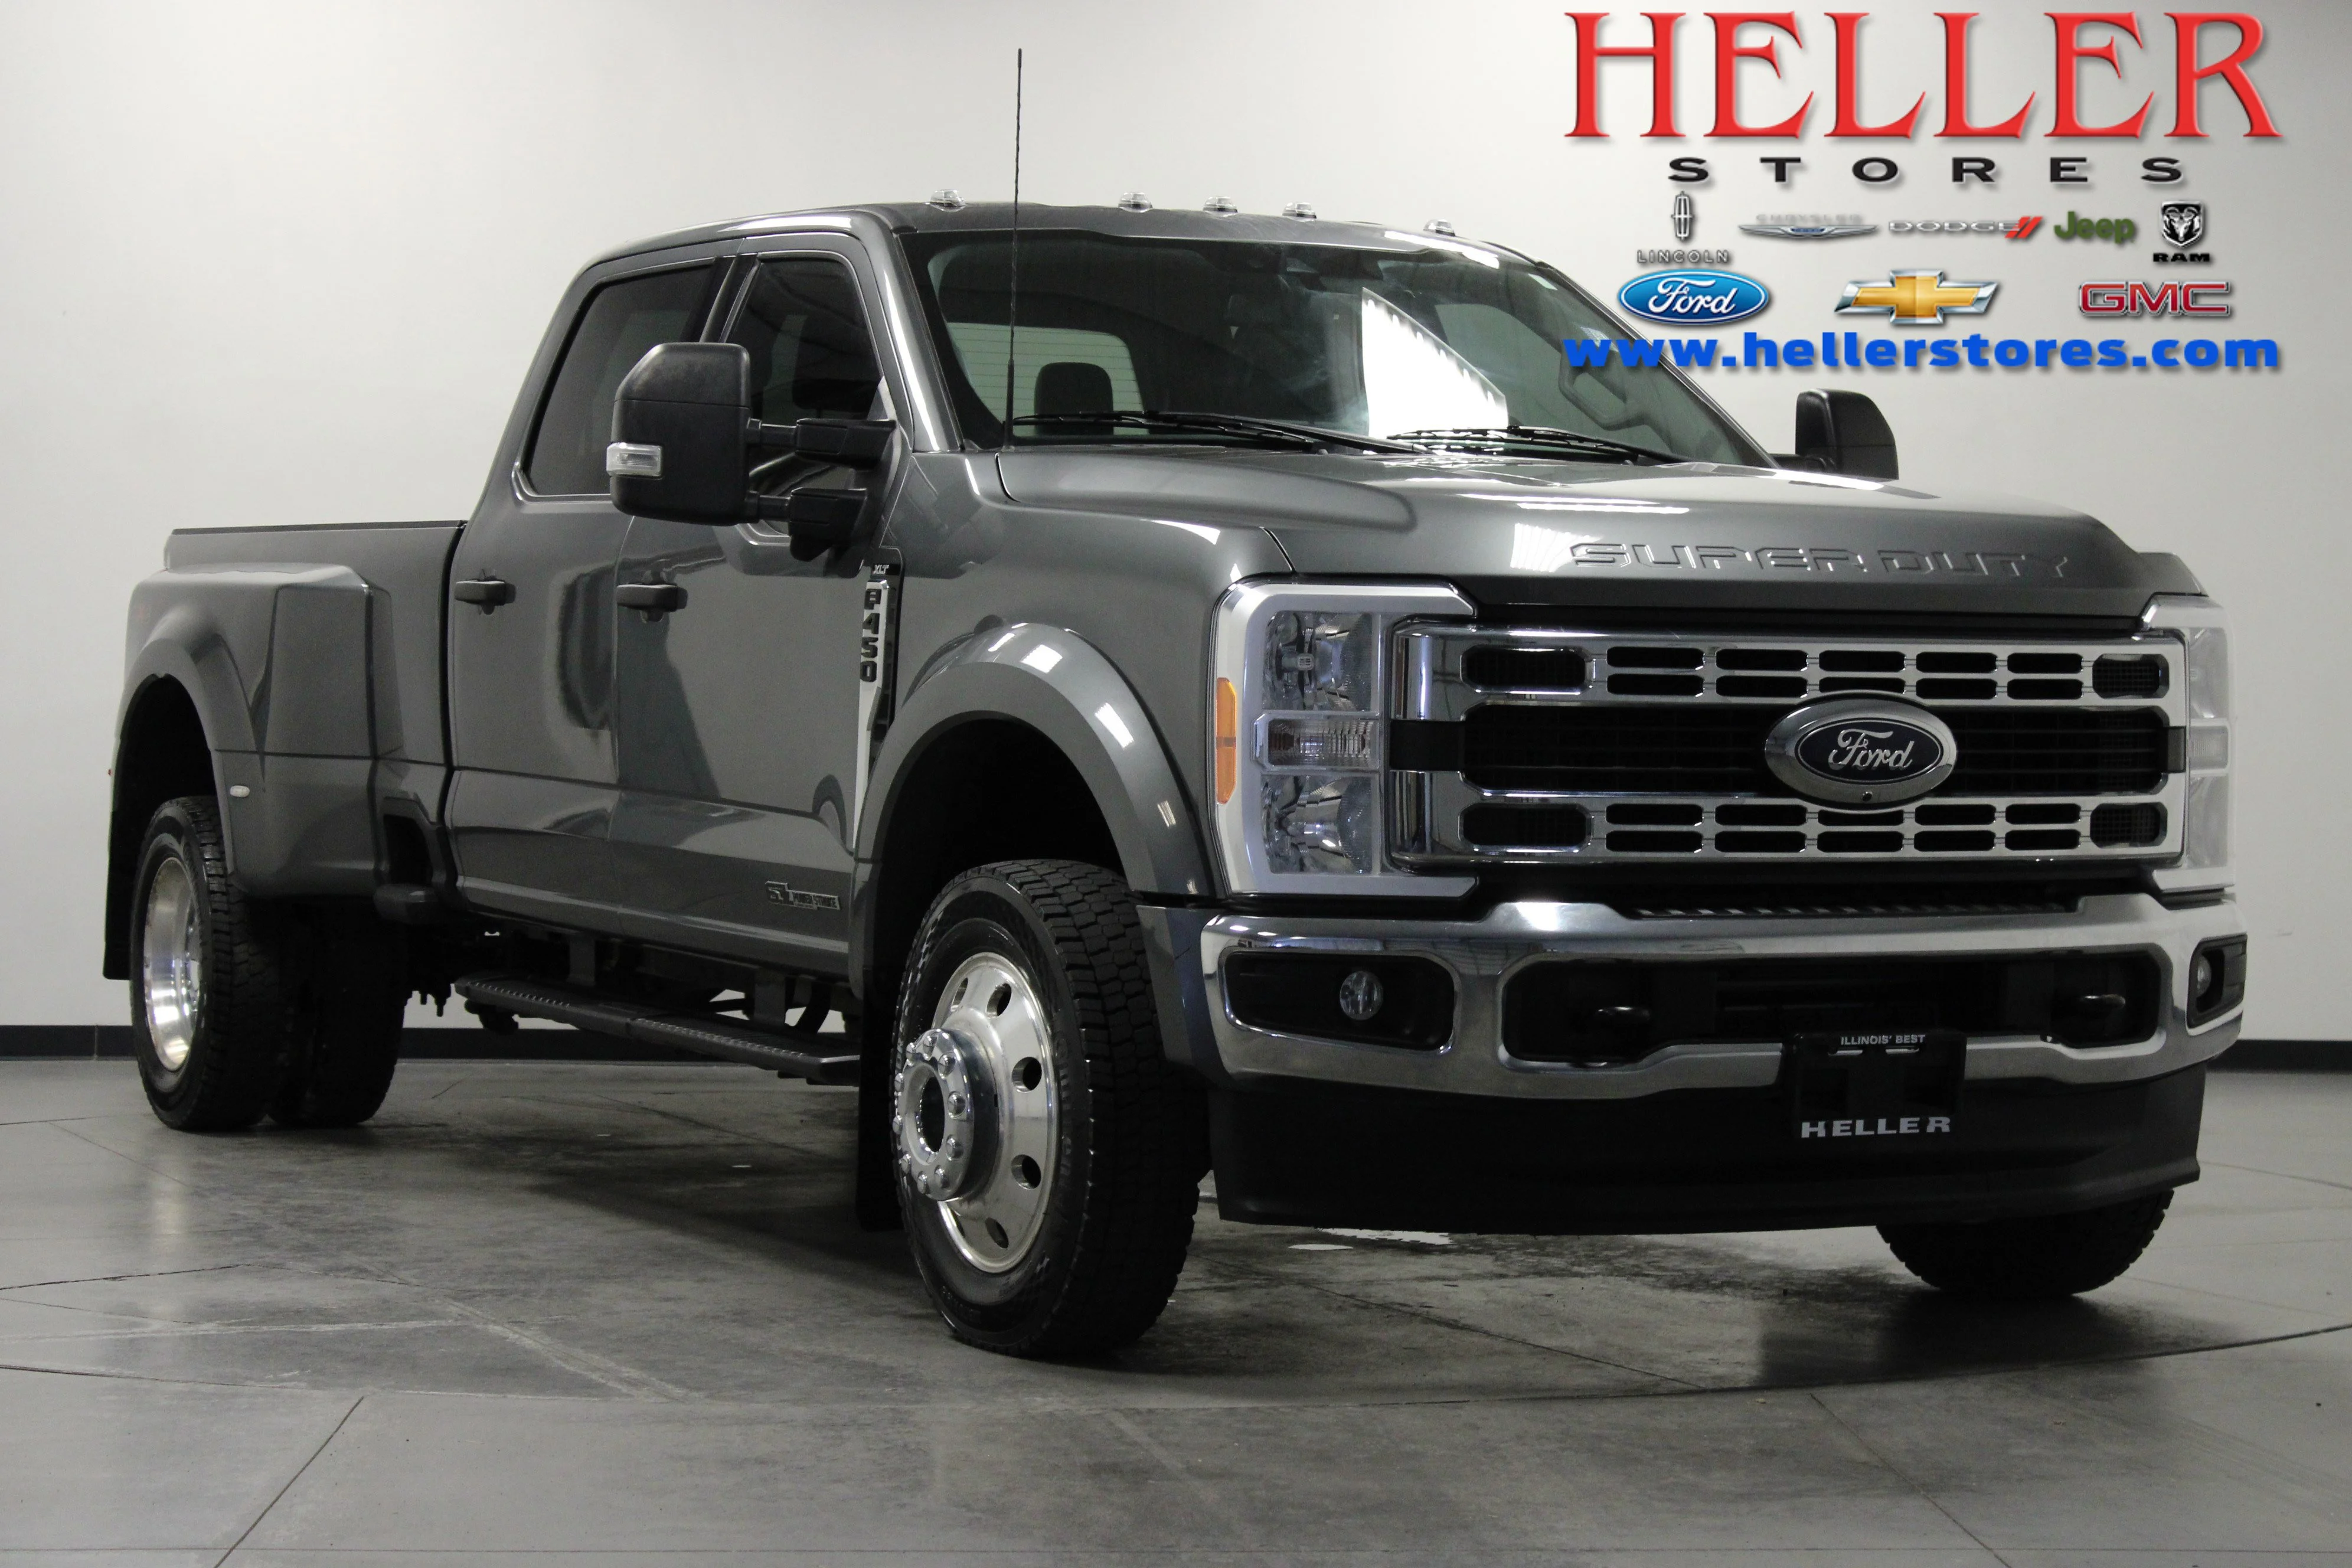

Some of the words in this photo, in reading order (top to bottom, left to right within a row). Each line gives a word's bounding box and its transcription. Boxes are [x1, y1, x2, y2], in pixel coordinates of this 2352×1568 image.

[1570, 543, 1867, 571] SUPER
[1881, 549, 2069, 577] DUTY
[1828, 729, 1913, 770] Ford
[1896, 1035, 1925, 1043] BEST
[1801, 1116, 1951, 1138] HELLER
